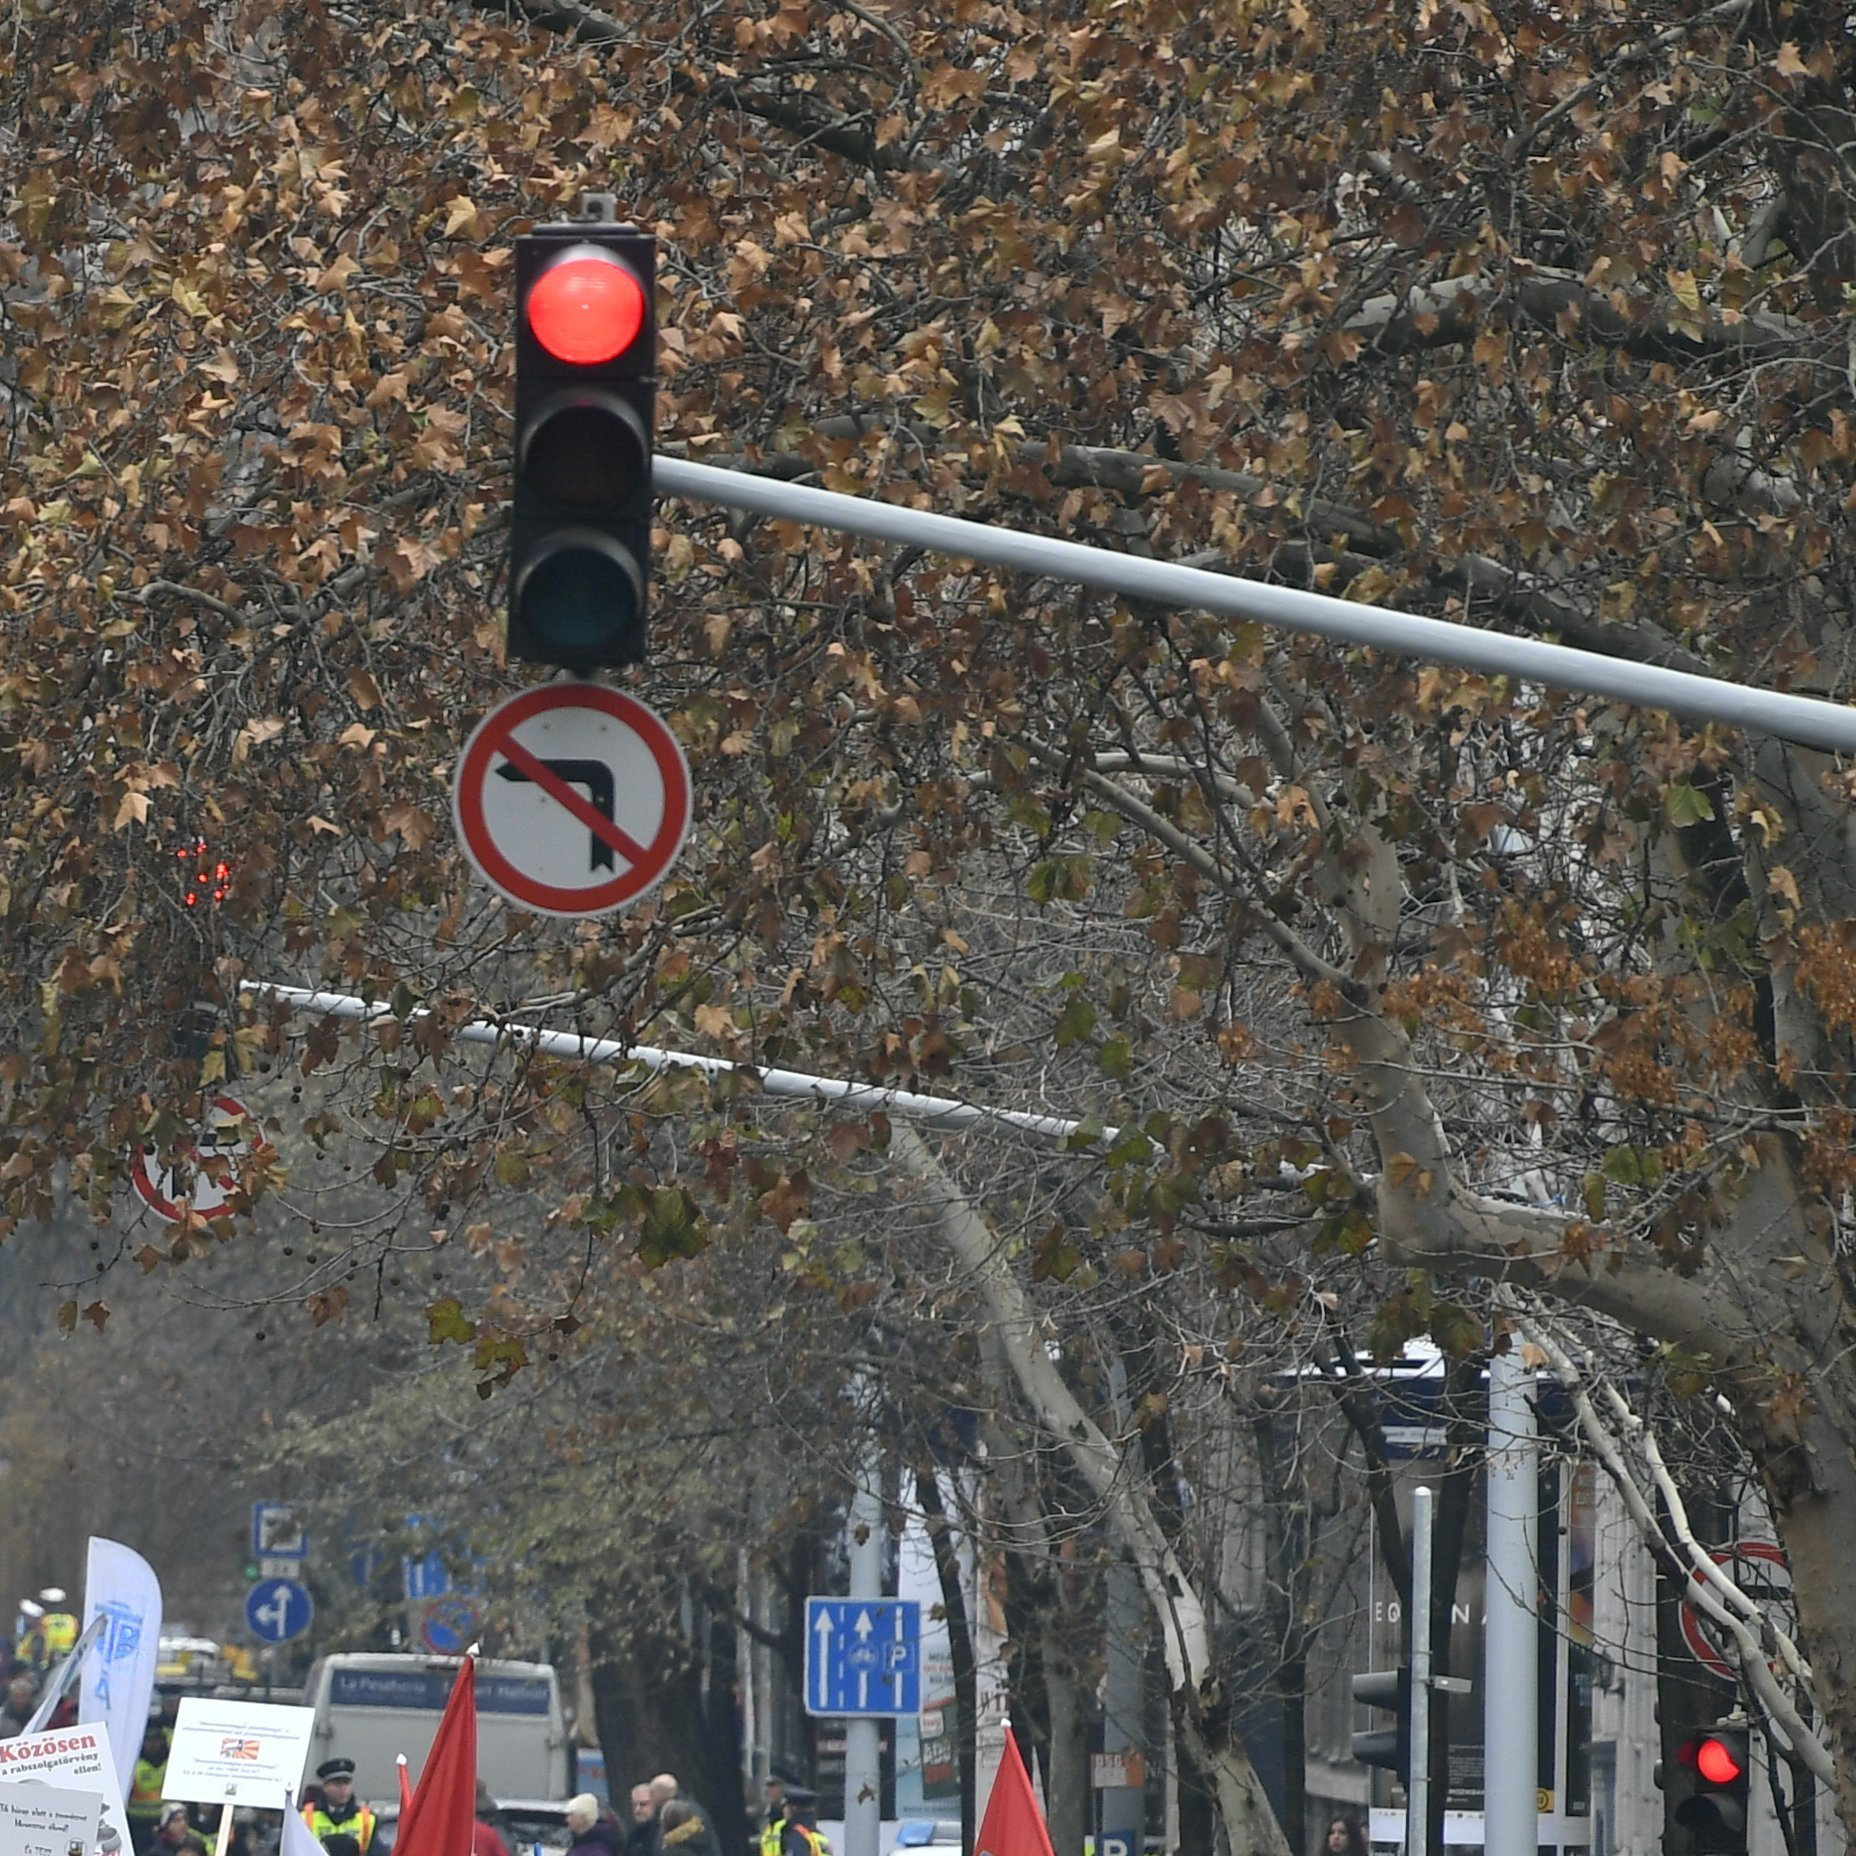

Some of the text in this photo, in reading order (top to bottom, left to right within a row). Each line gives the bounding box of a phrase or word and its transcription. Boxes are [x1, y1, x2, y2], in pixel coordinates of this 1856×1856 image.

[1, 1751, 100, 1776] a rabszolgatörvény
[73, 1762, 102, 1776] ellen!
